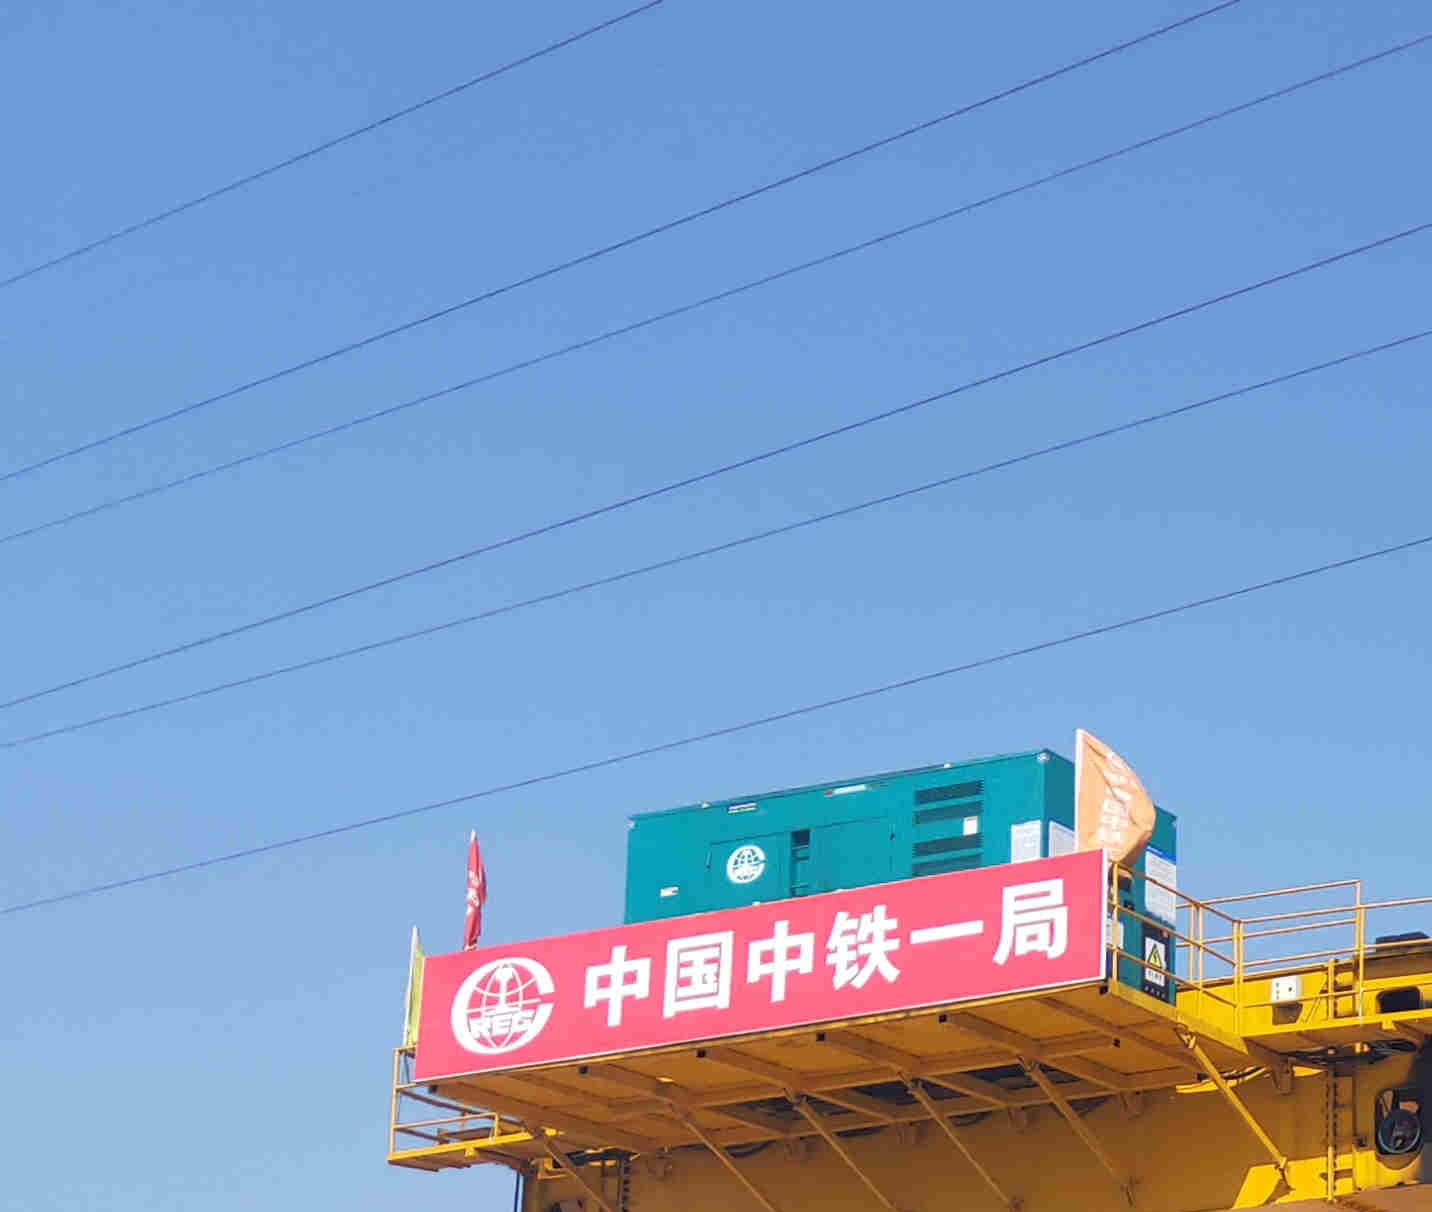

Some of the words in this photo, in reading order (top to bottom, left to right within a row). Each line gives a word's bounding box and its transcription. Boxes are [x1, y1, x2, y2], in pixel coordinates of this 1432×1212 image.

[583, 878, 1069, 1027] 中国中铁一局
